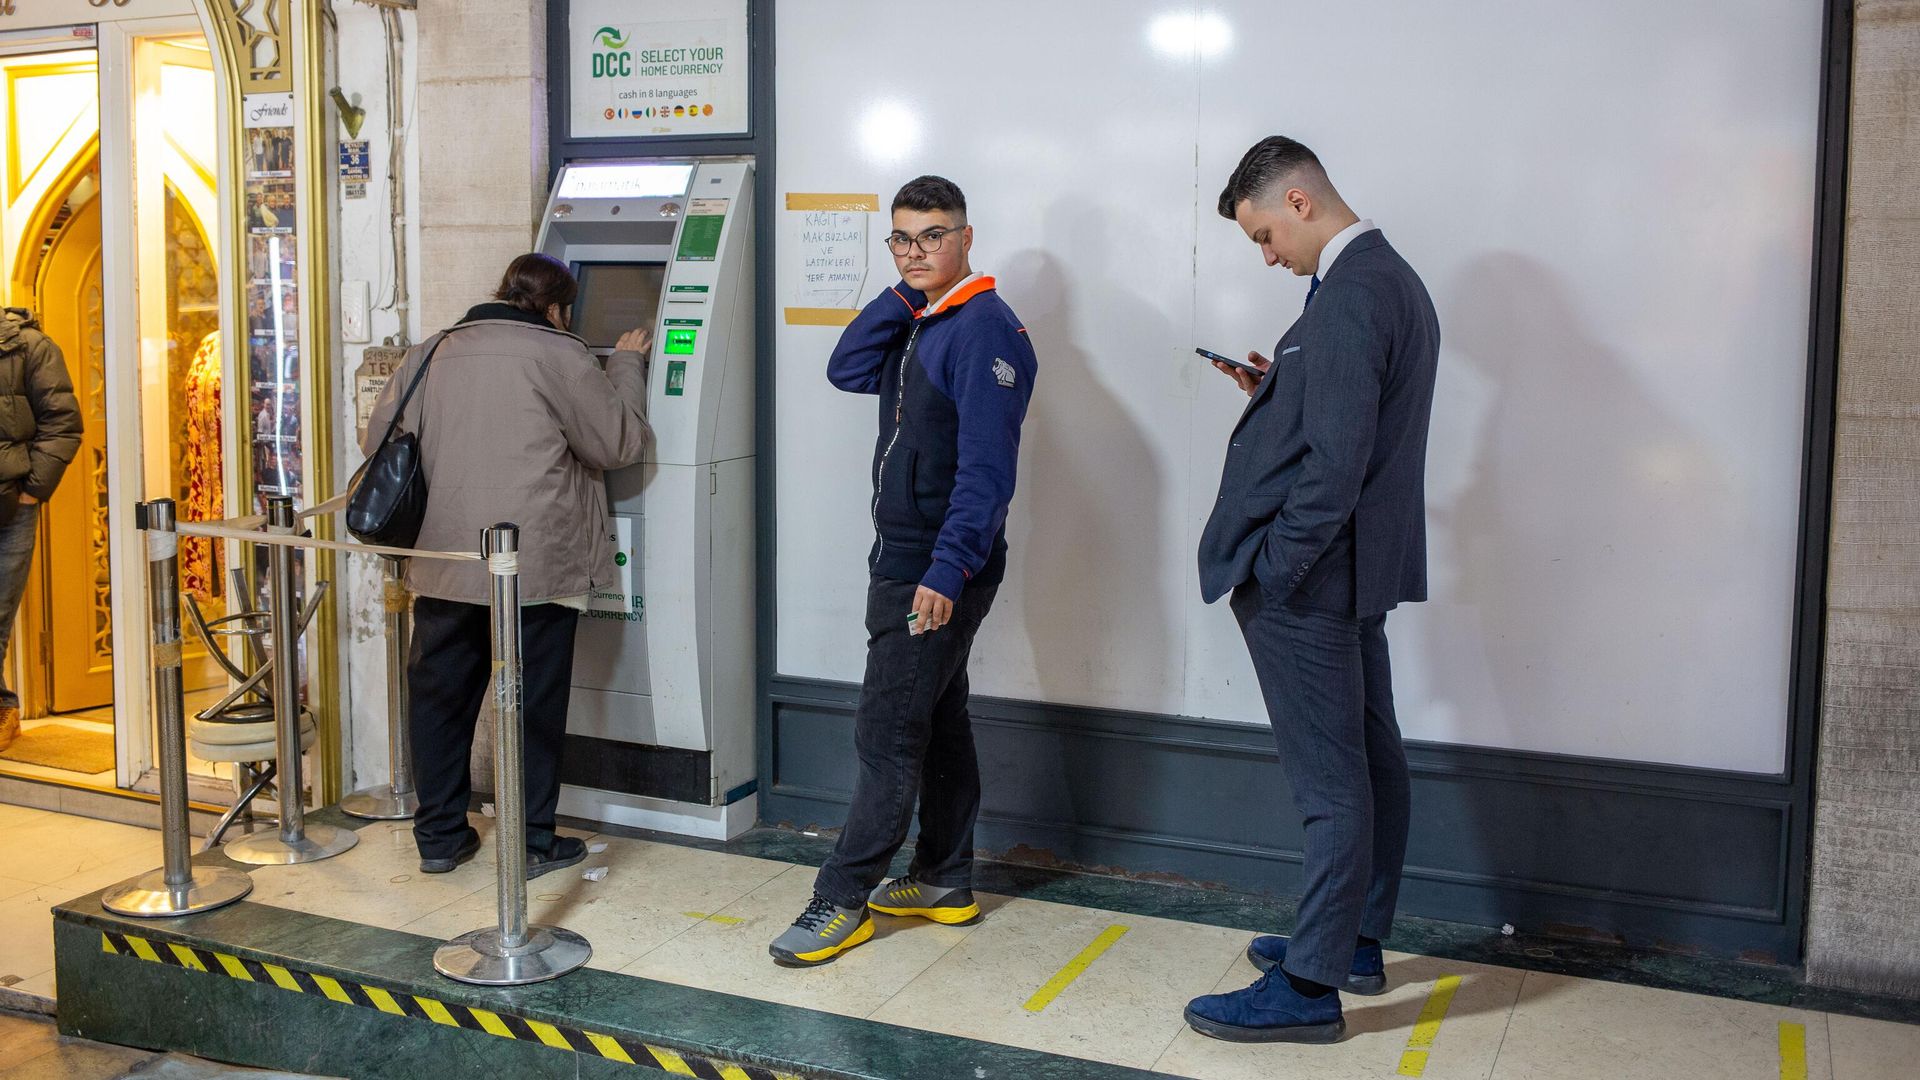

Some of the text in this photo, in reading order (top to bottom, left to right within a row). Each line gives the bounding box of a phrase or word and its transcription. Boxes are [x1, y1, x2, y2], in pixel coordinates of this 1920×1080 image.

[641, 47, 723, 63] SELECT YOUR
[592, 51, 631, 78] DCC
[641, 63, 723, 76] HOME CURRENCY
[618, 88, 698, 100] cash in 8 languages
[250, 102, 289, 121] Friends
[820, 246, 834, 255] VE
